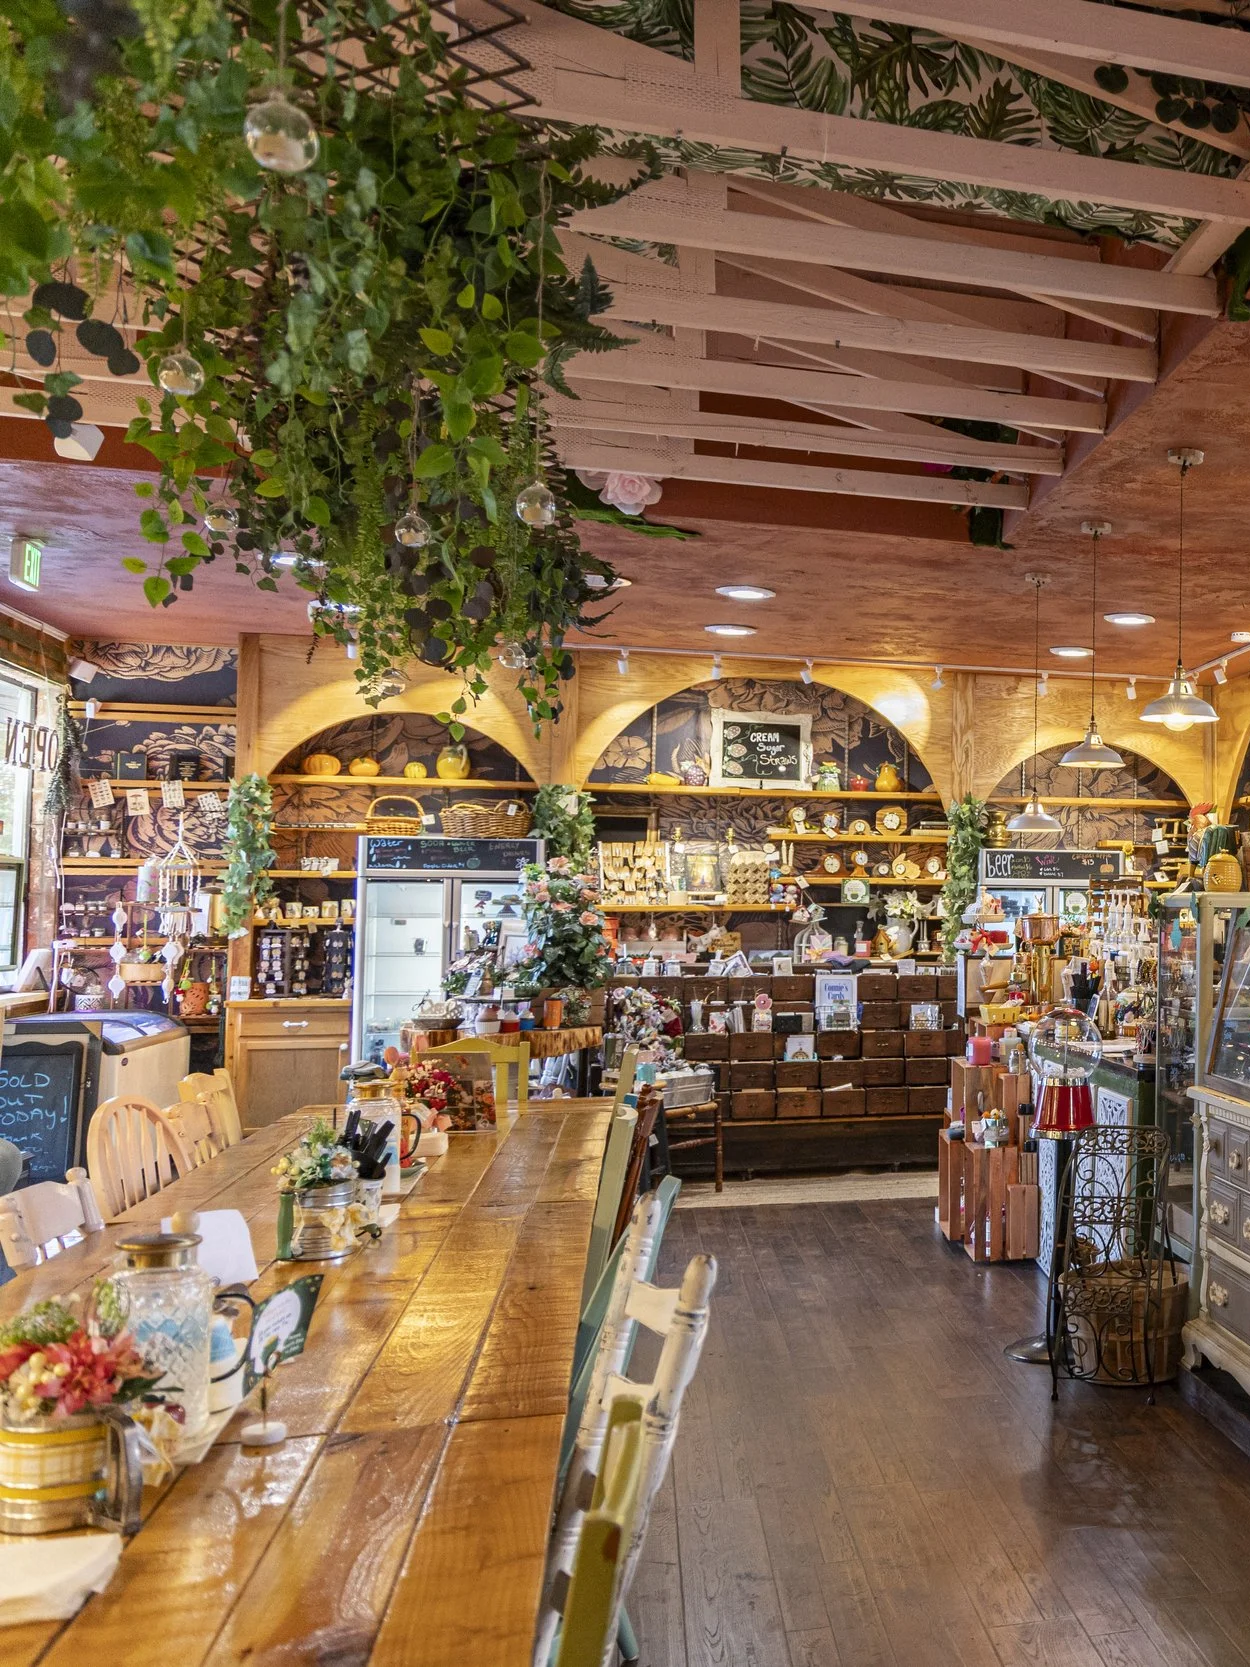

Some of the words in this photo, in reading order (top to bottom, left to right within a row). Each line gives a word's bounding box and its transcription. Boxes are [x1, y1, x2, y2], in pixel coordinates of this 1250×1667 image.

[750, 732, 780, 743] CREAM
[756, 742, 786, 756] Sugar
[369, 839, 404, 848] Water
[986, 853, 1014, 877] beer
